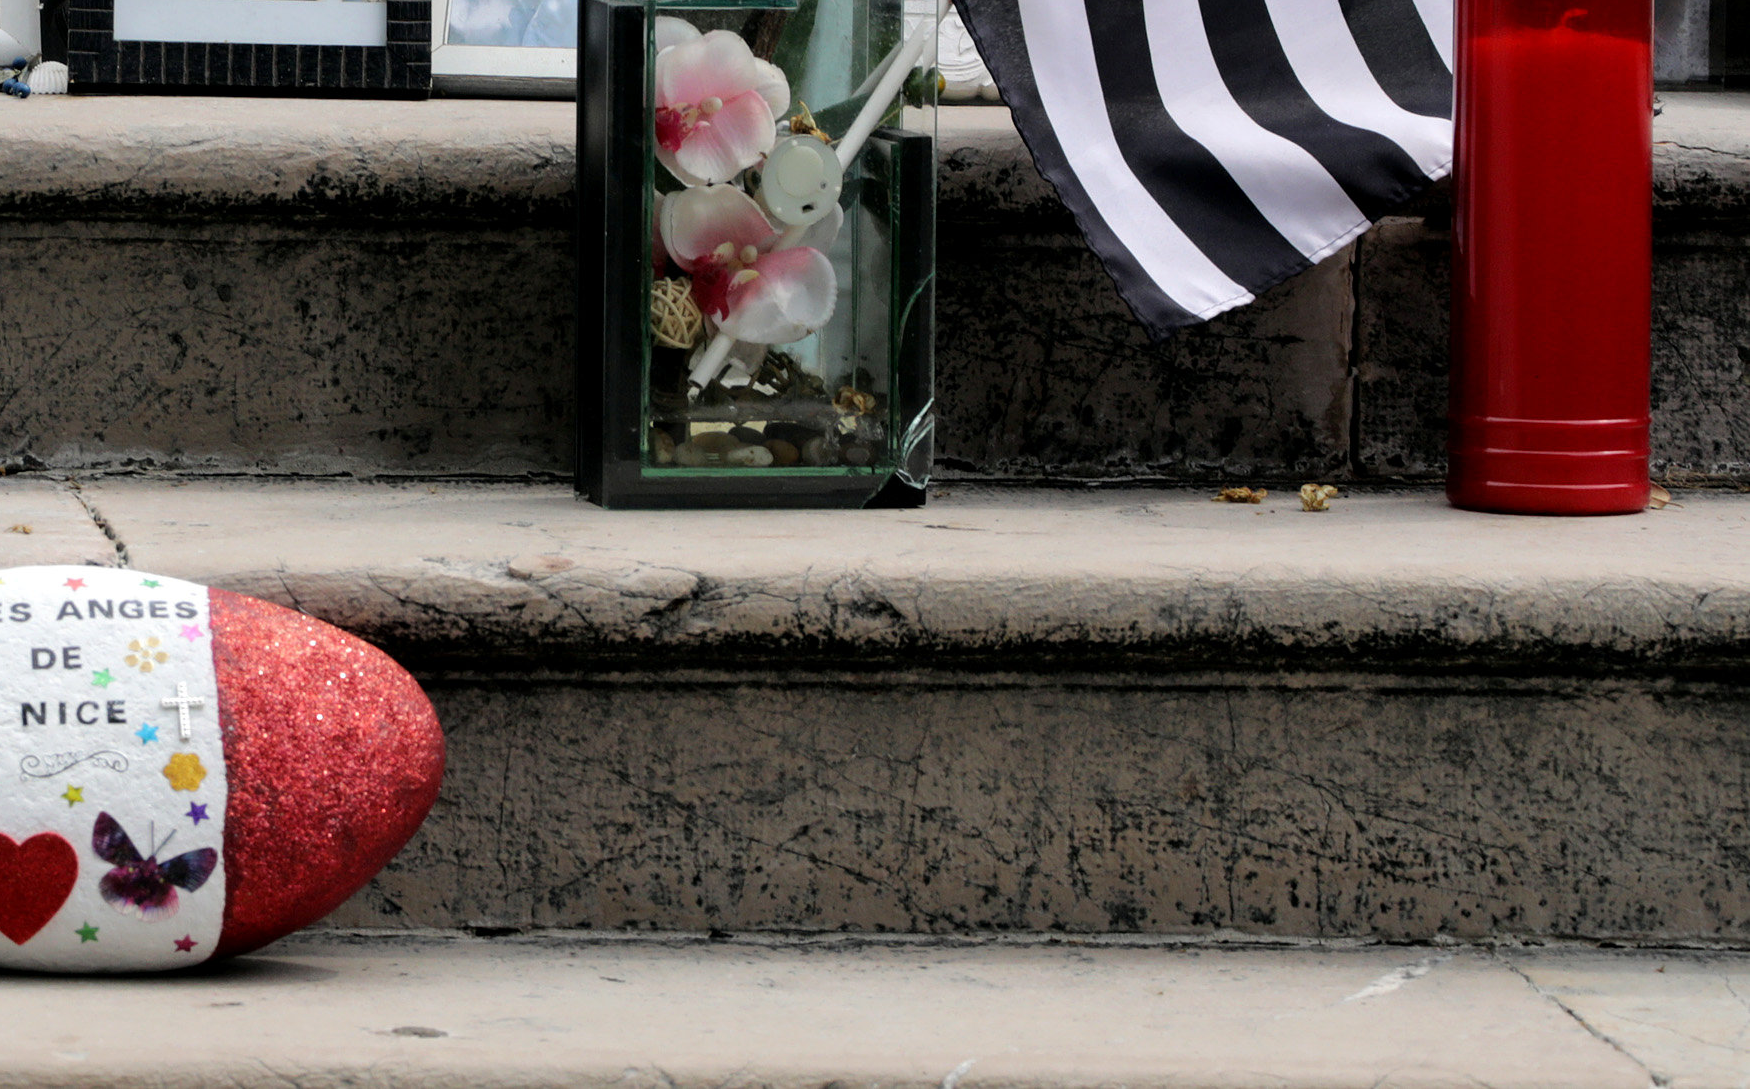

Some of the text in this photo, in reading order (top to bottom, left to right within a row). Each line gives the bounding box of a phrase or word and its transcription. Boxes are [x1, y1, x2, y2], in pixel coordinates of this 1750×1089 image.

[56, 598, 199, 622] ANGES
[30, 646, 83, 671] DE
[21, 699, 128, 728] NICE
